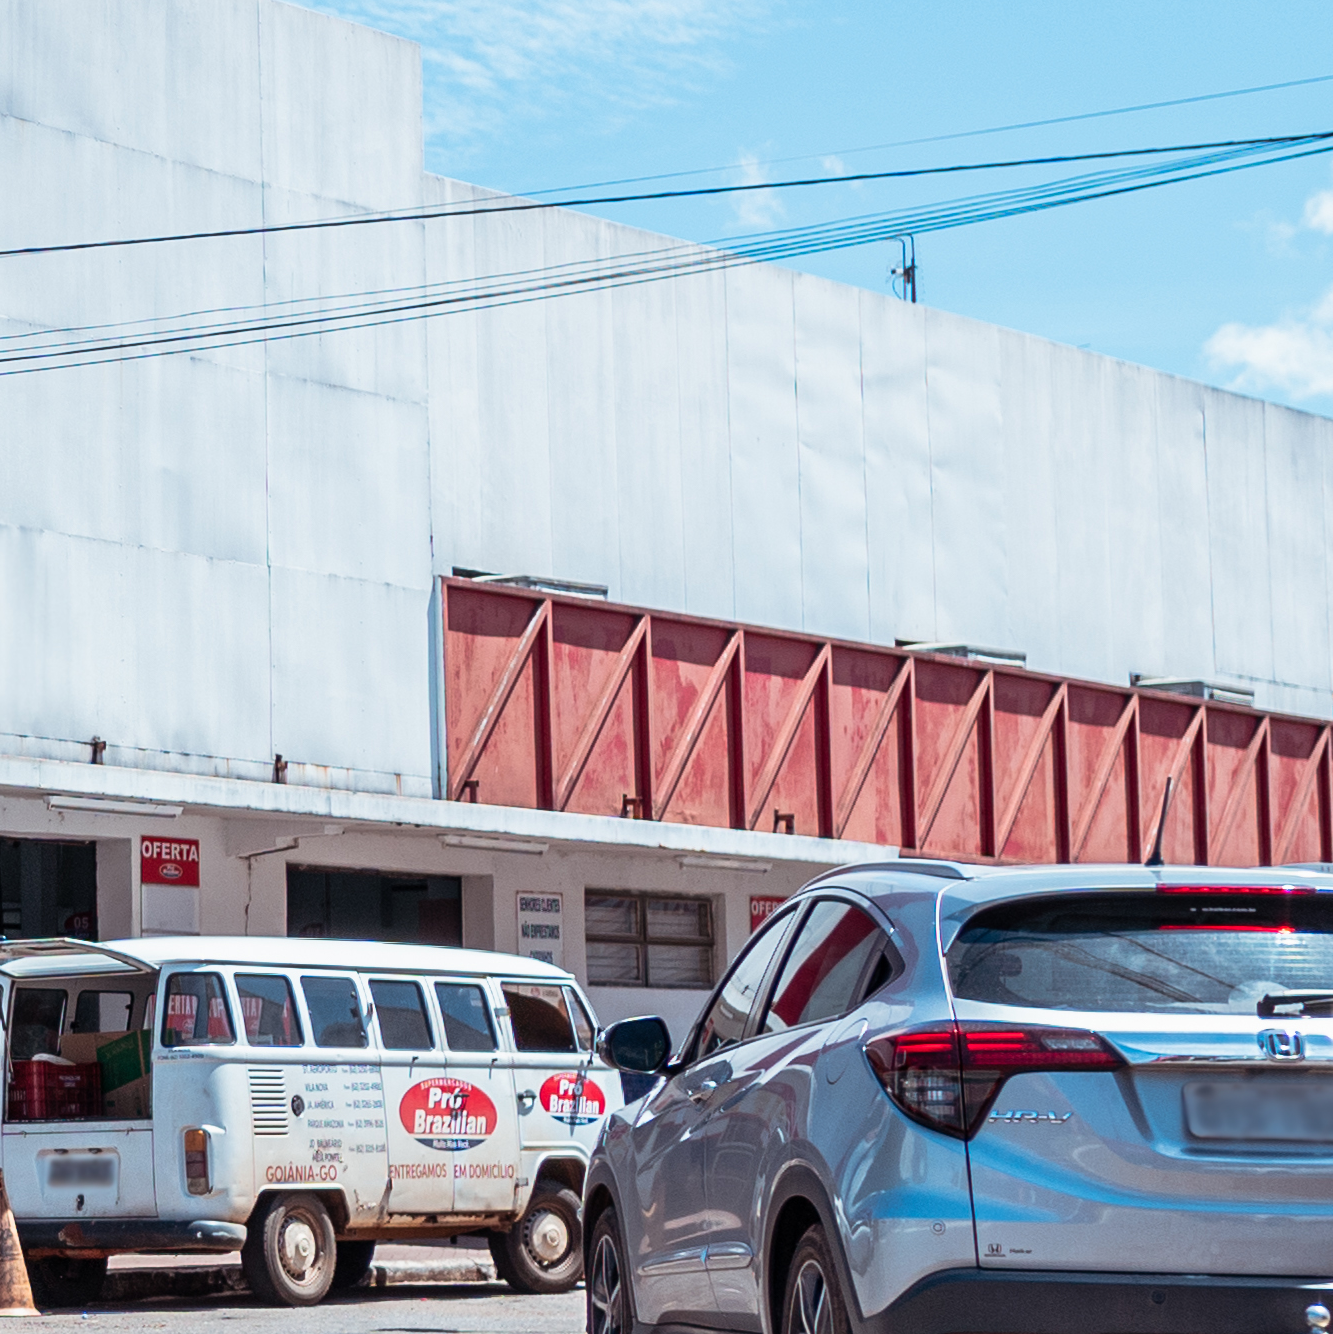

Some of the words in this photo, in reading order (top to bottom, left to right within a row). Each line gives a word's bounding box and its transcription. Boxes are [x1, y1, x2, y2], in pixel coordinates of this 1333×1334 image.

[142, 841, 200, 863] OFERTA
[73, 916, 89, 929] 05
[420, 1077, 472, 1091] SUPERMERCADOS
[559, 1078, 583, 1096] Pró
[428, 1087, 463, 1110] Pró
[549, 1094, 600, 1115] Brazilian
[413, 1109, 487, 1135] Brazilian
[988, 1110, 1073, 1124] HR-V
[266, 1161, 338, 1183] GOIÂNIA-GO
[389, 1163, 448, 1180] ENTREGAMOS
[453, 1165, 468, 1179] EM
[469, 1160, 515, 1179] DOMICÍLIO
